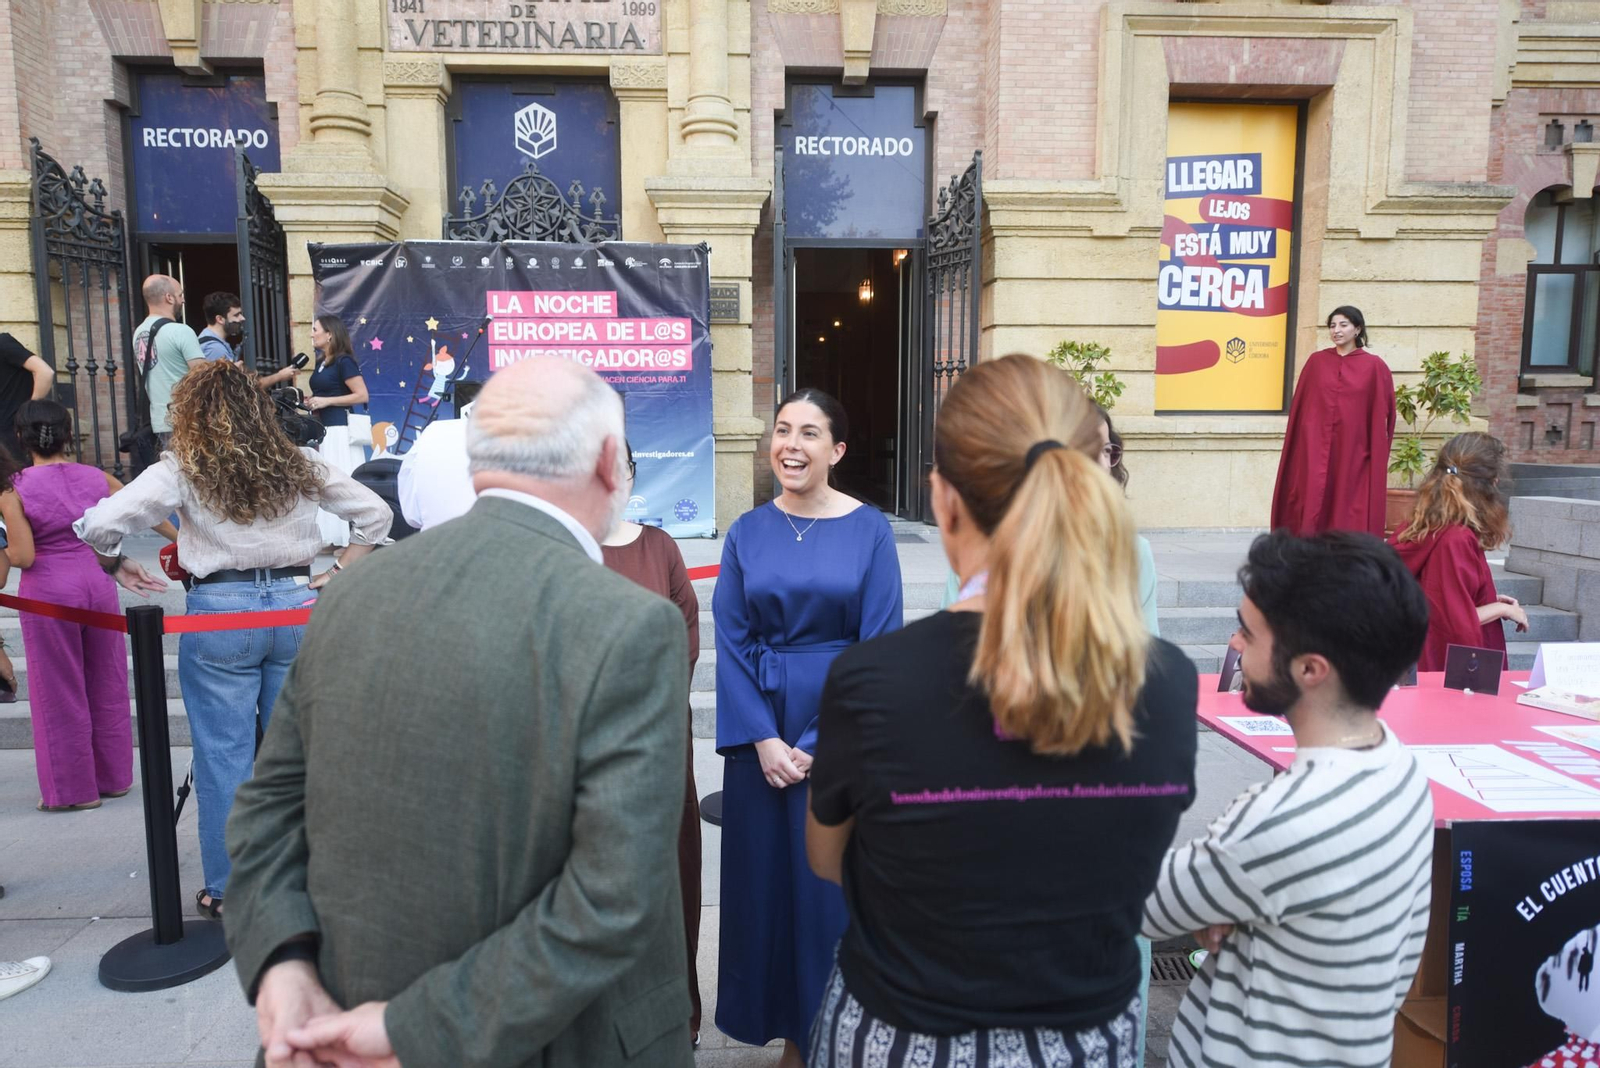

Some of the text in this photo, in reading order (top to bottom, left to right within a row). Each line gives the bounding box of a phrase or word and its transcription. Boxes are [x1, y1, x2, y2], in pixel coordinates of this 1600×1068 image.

[392, 0, 425, 13] 1941
[509, 4, 537, 18] DE
[621, 2, 656, 16] 1999
[404, 19, 644, 49] VETERINARIA
[142, 127, 269, 149] RECTORADO
[795, 135, 914, 156] RECTORADO
[1168, 159, 1254, 193] LLEGAR
[1208, 199, 1251, 220] LEJOS
[1174, 224, 1272, 257] ESTÁ MUY
[1158, 265, 1265, 309] CERCA
[492, 294, 612, 314] LA NOCHE
[494, 322, 686, 341] EUROPEA DE L@S
[626, 375, 657, 384] CIENCIA
[658, 375, 678, 384] PARA
[1460, 850, 1472, 891] ESPOSA
[1456, 905, 1470, 922] TÍA
[1516, 896, 1544, 921] EL
[1453, 942, 1466, 986] MARTHA
